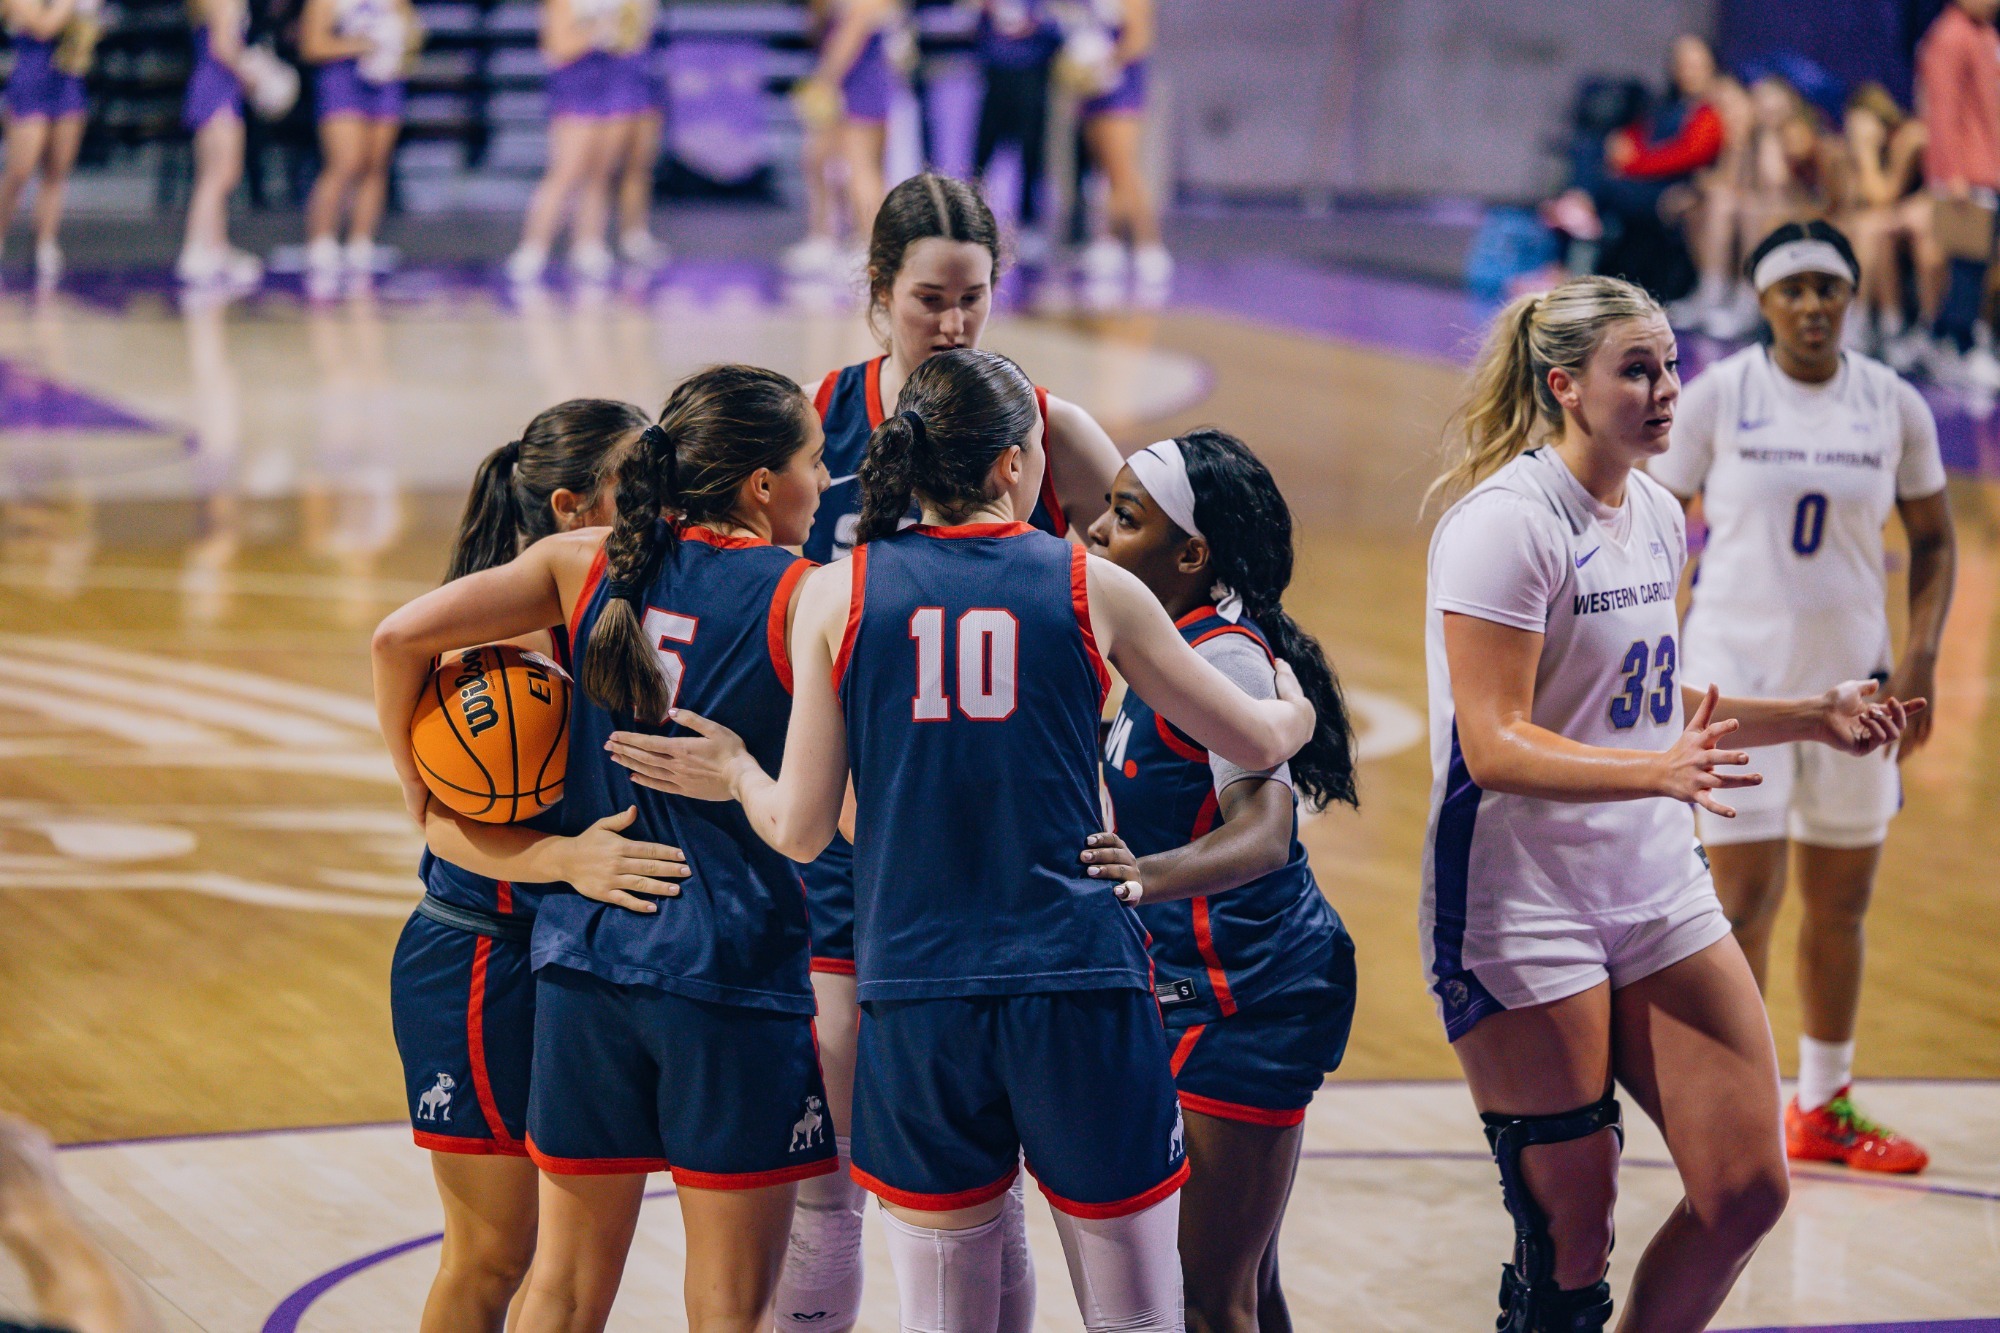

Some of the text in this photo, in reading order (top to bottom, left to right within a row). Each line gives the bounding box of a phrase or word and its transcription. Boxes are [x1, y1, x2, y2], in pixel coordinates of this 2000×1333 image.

[1792, 491, 1829, 557] 0
[1573, 587, 1639, 616] WESTERN
[633, 605, 699, 726] 5
[908, 606, 1020, 722] 10
[1607, 633, 1677, 733] 33
[1181, 985, 1189, 996] S
